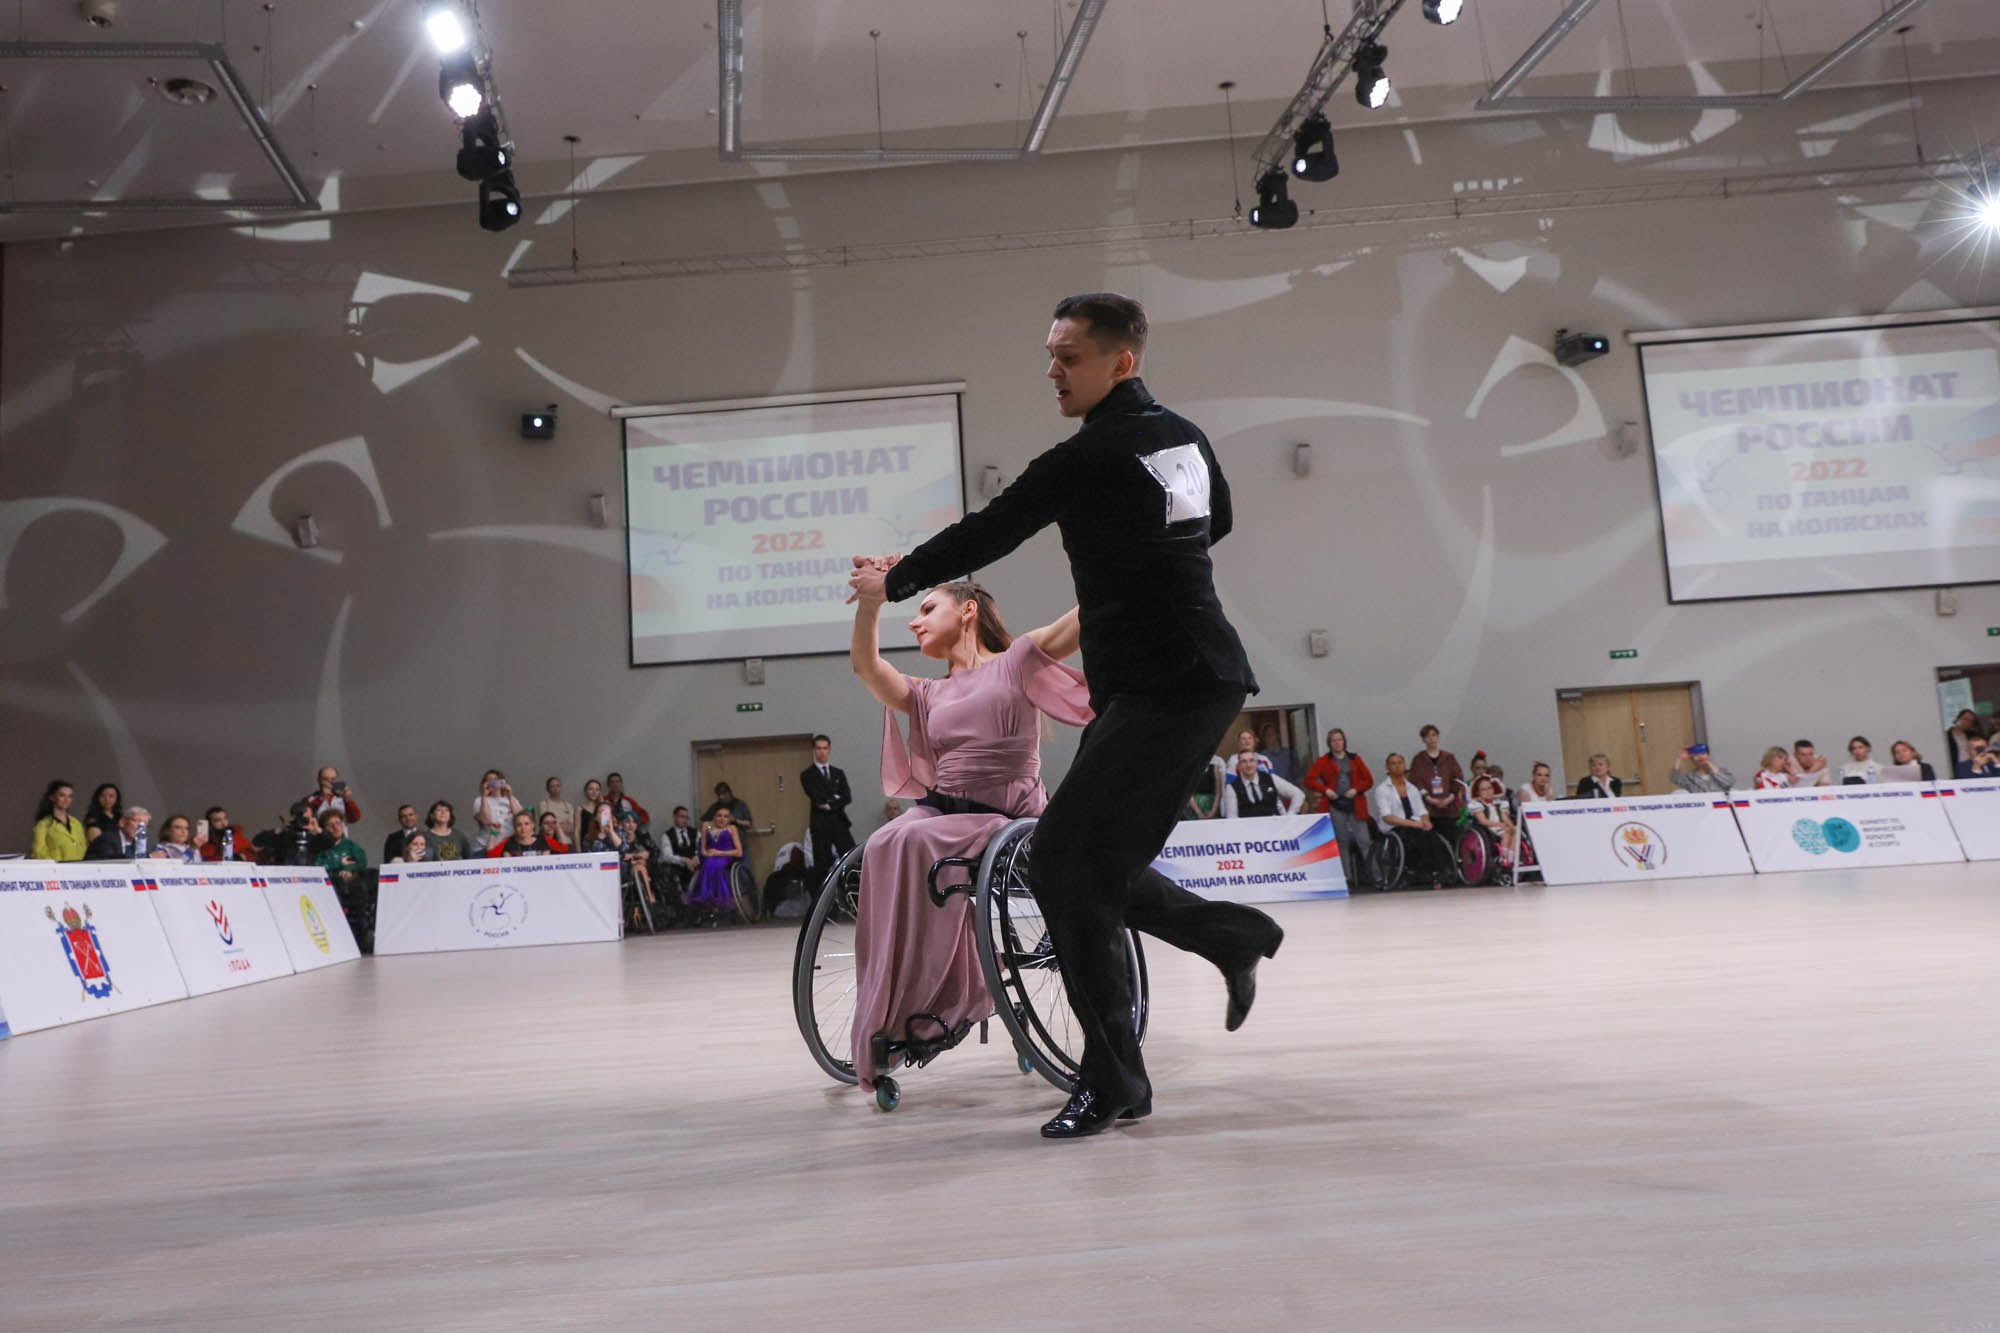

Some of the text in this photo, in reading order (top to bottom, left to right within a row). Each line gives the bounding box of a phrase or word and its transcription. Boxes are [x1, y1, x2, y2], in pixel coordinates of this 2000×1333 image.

[1679, 371, 1959, 417] ЧЕМПИОНАТ
[1737, 414, 1914, 454] РОССИИ
[653, 444, 917, 491] ЧЕМПИОНАТ
[1791, 458, 1868, 481] 2022
[704, 486, 869, 526] РОССИИ
[1757, 485, 1910, 512] ПО ТАНЦАМ
[1747, 511, 1928, 539] НА КОЛЯСКАХ
[751, 530, 825, 554] 2022
[717, 561, 751, 584] ПО
[706, 585, 856, 610] НА КОЛЯСКА
[1245, 839, 1300, 854] РОССИИ
[406, 870, 451, 879] ЧЕМПИОНАТ
[453, 868, 480, 876] РОССИИ
[483, 867, 499, 875] 2022
[512, 865, 542, 873] ТАНЦАМ
[1216, 860, 1245, 870] 2022
[19, 880, 44, 891] РОССИИ
[1178, 871, 1307, 889] ТАНЦАМ НА КОЛЯСКАХ
